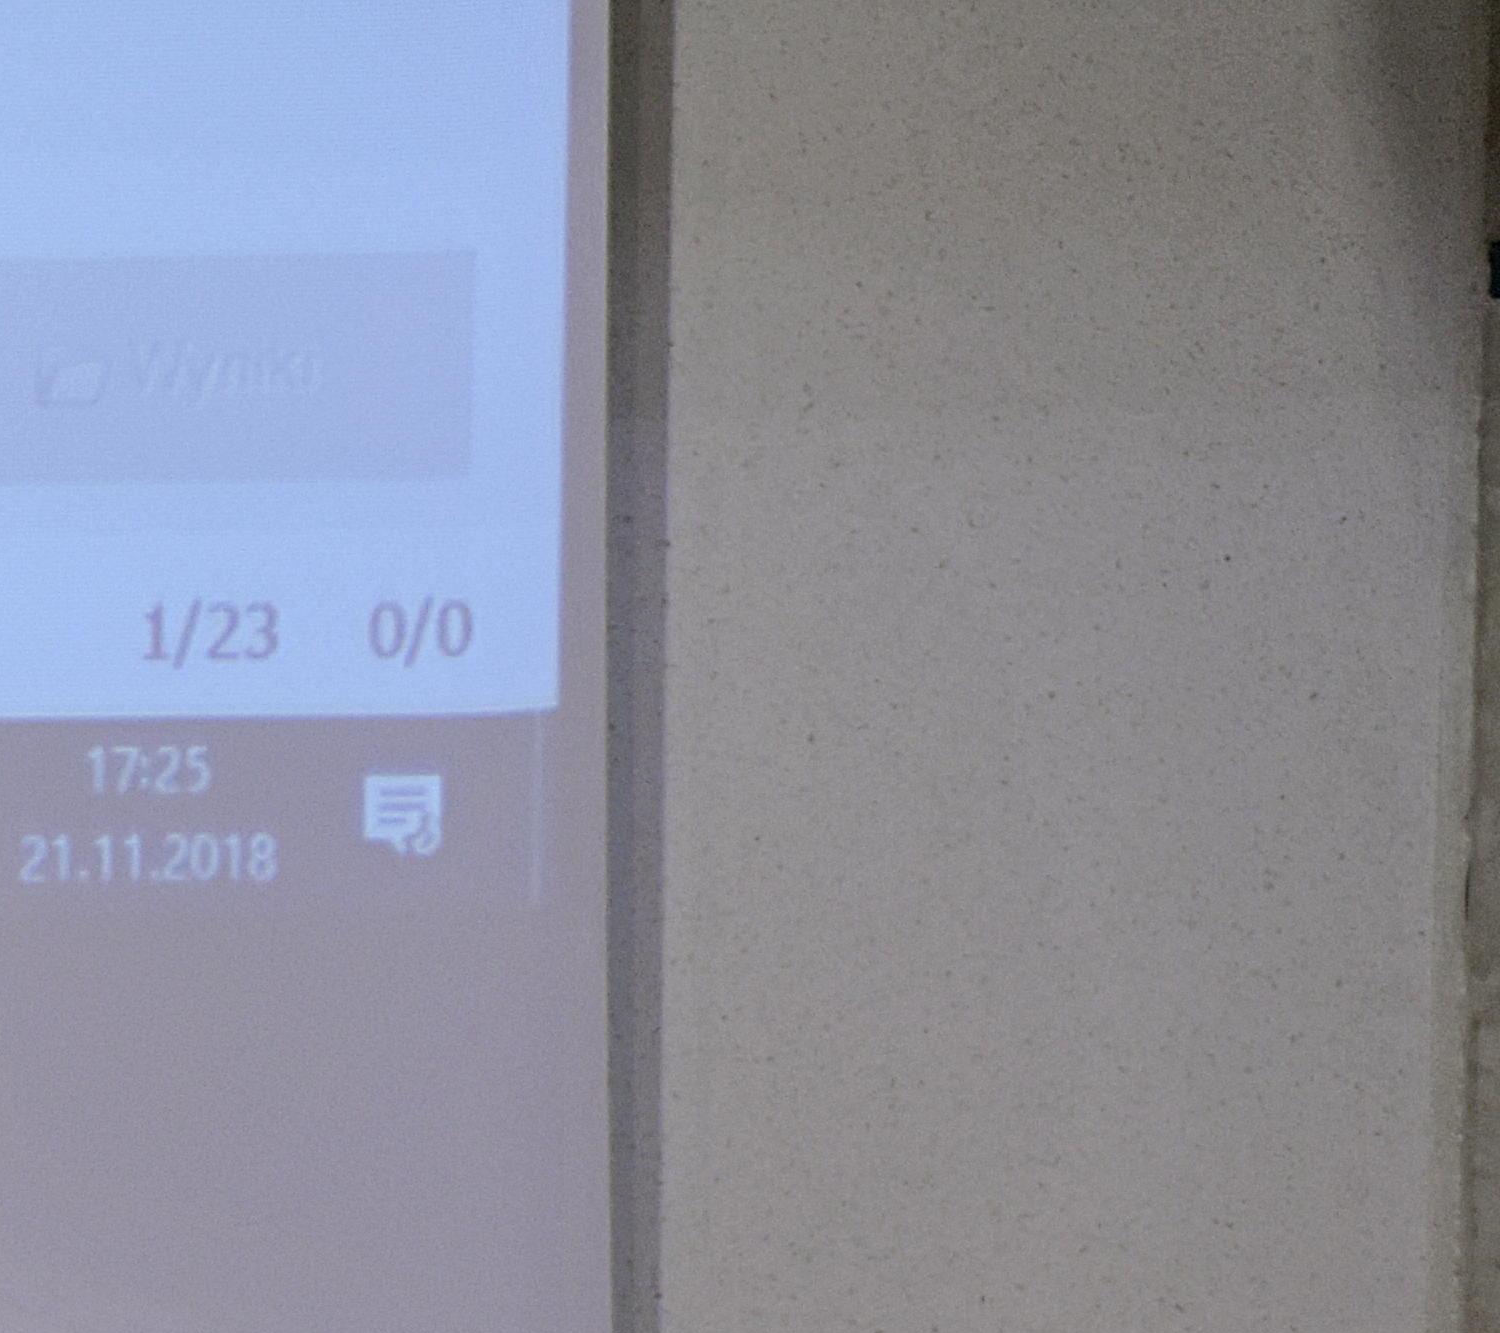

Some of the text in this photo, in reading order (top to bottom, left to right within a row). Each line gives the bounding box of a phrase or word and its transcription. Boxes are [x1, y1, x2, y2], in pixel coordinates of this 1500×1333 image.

[141, 596, 474, 670] 1/23 0/0
[86, 745, 212, 795] 17:25
[17, 831, 280, 884] 21.11.2018
